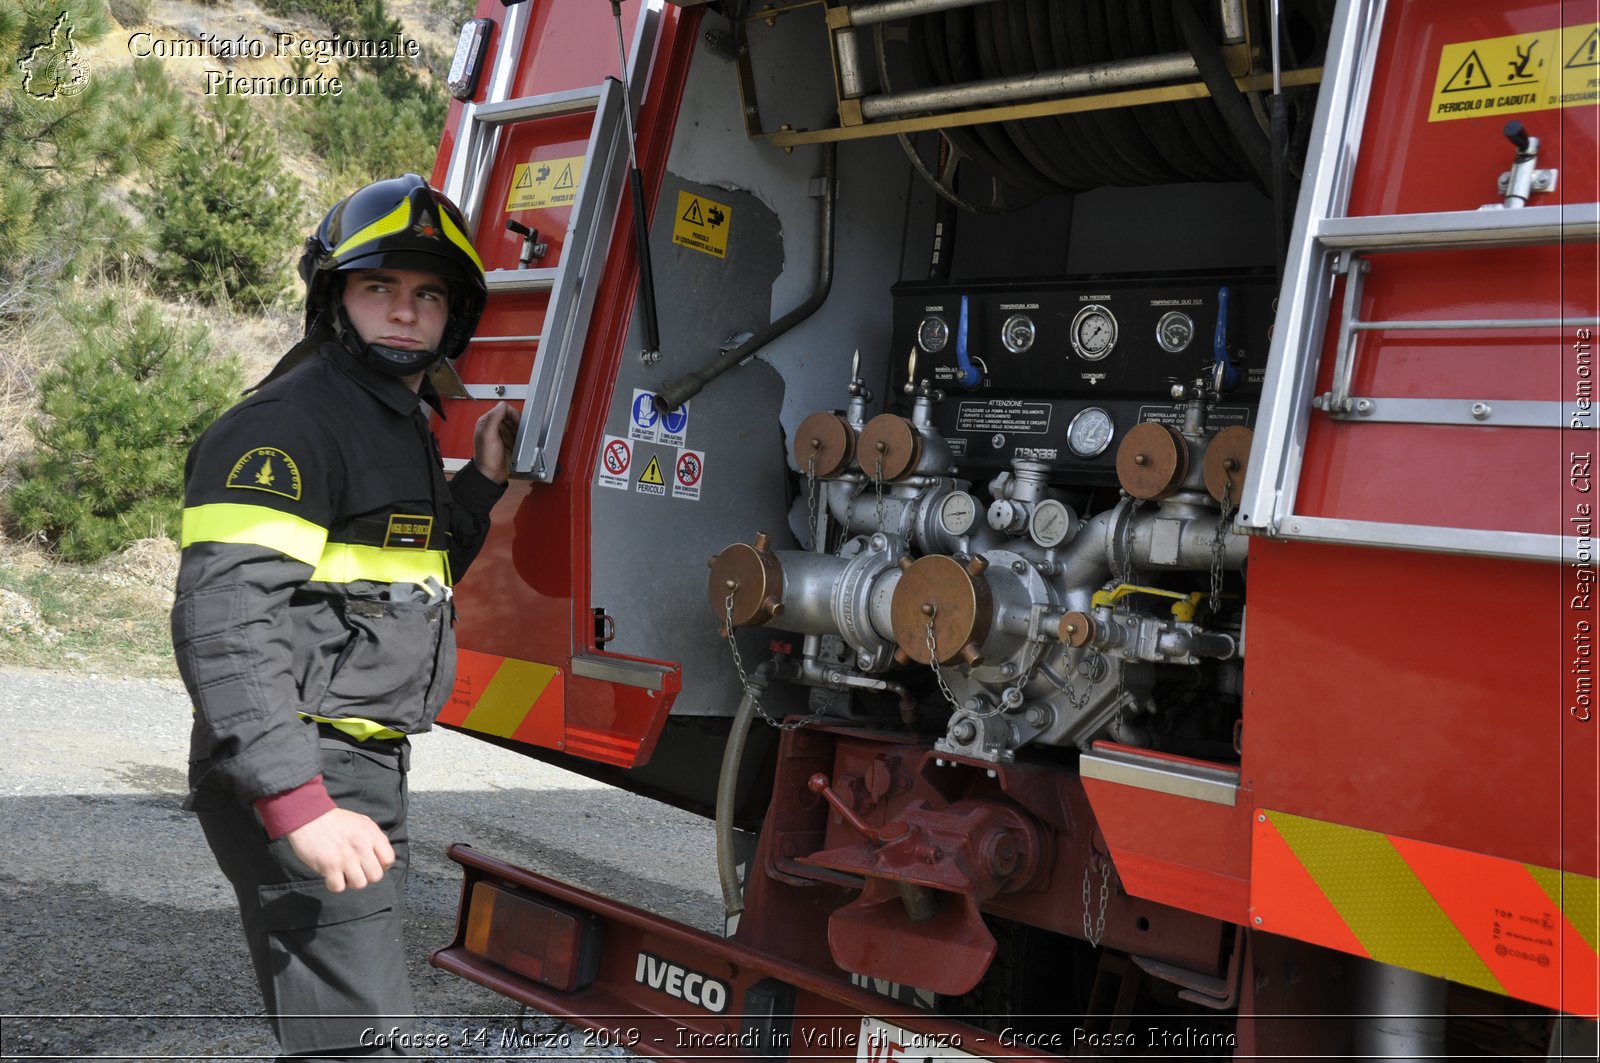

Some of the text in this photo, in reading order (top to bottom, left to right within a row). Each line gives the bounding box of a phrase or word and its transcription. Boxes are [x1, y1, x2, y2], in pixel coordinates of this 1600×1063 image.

[1437, 94, 1536, 113] PERICOLO DI CADUTA
[637, 483, 664, 495] PERICOLO
[635, 953, 726, 1012] IVECO
